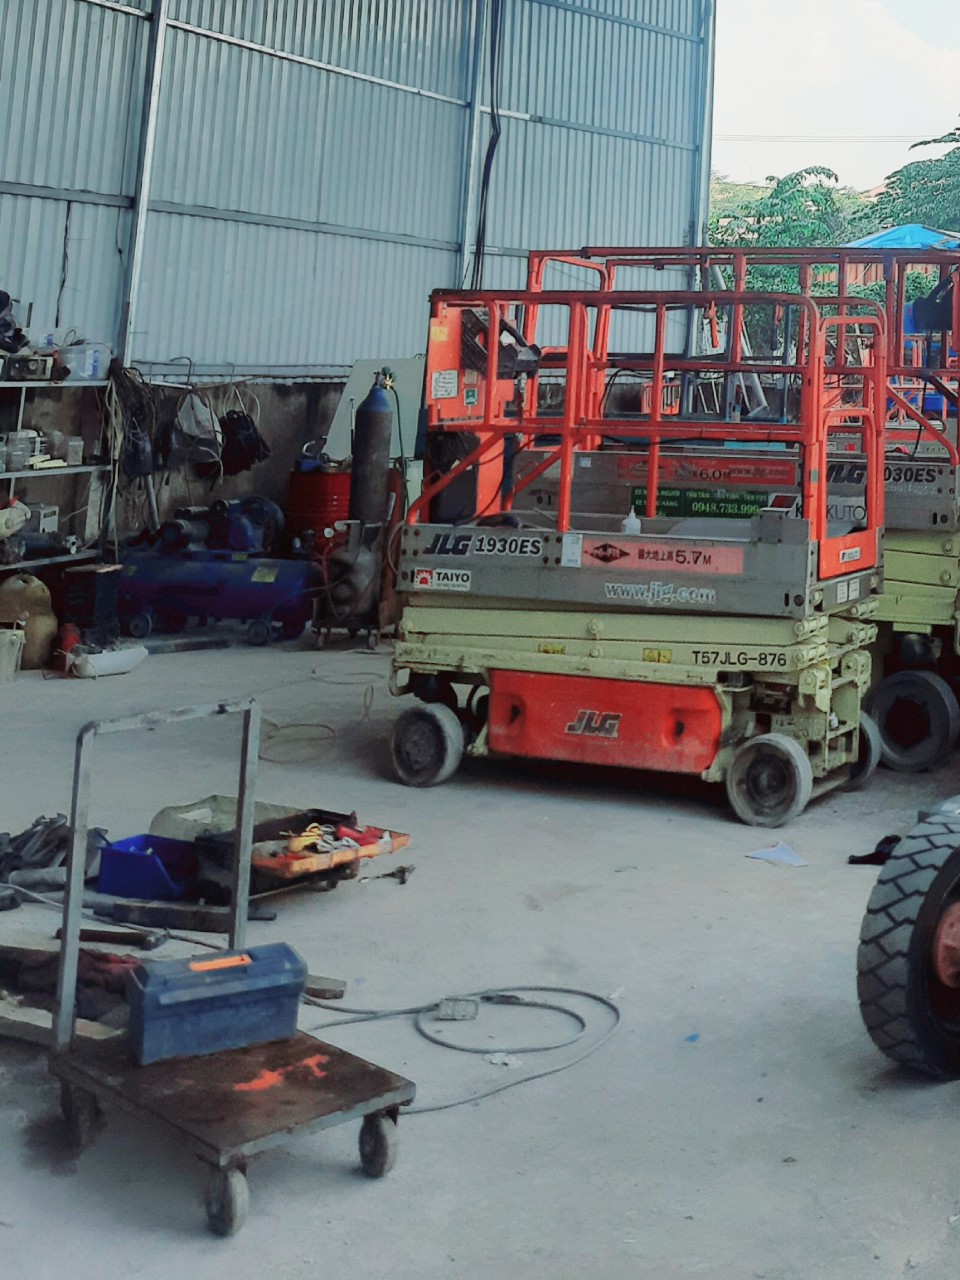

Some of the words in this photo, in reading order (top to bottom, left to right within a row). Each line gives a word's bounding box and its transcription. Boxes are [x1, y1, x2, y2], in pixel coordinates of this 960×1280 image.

[884, 466, 936, 483] 030ES
[423, 533, 472, 556] JLG
[475, 536, 541, 555] 1930ES
[436, 572, 470, 583] TAIYO
[692, 650, 788, 667] T57JLG-876
[565, 709, 622, 739] JLG
